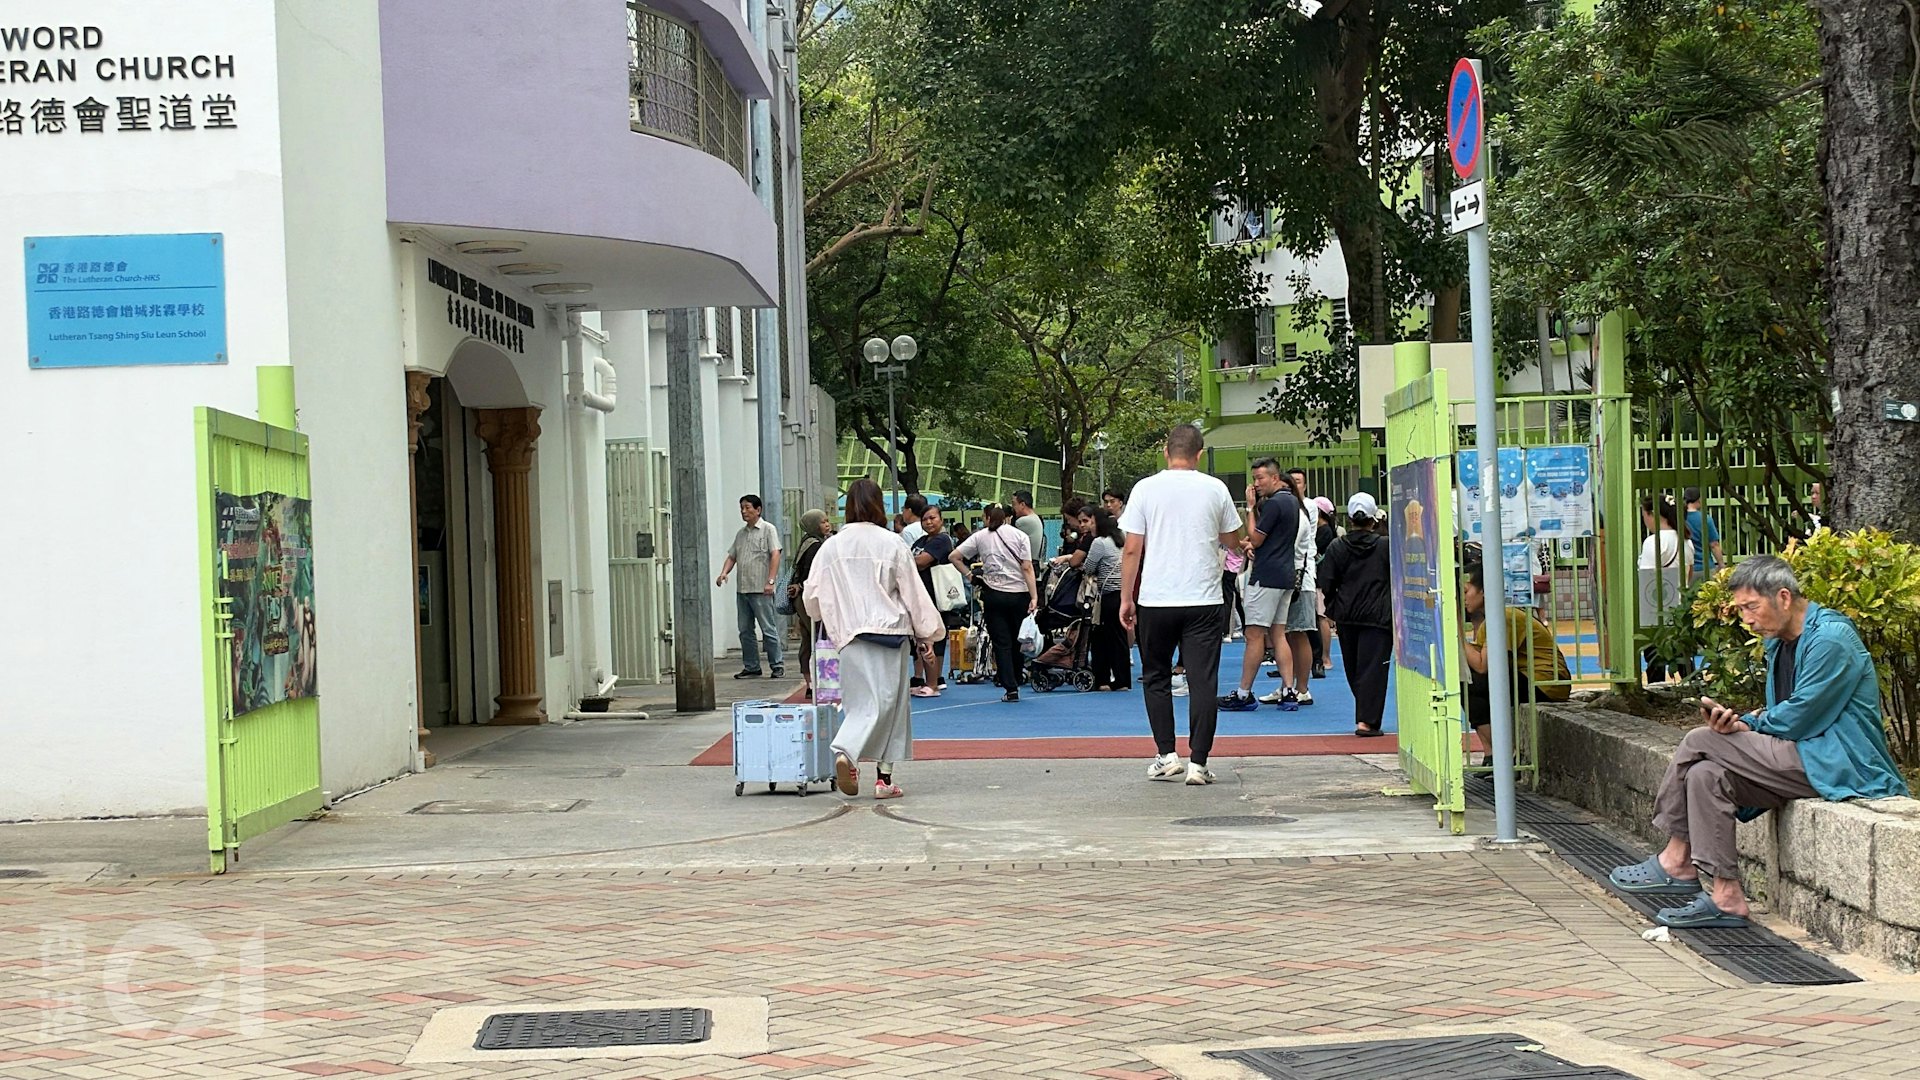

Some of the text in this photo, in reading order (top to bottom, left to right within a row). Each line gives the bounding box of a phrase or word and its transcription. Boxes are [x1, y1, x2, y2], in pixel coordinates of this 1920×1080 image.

[0, 26, 104, 52] WORD
[96, 55, 235, 82] CHURCH
[63, 276, 77, 284] The
[78, 275, 113, 283] Lutheran
[49, 329, 207, 342] Lutheran Tsang Shing Siu Leun School
